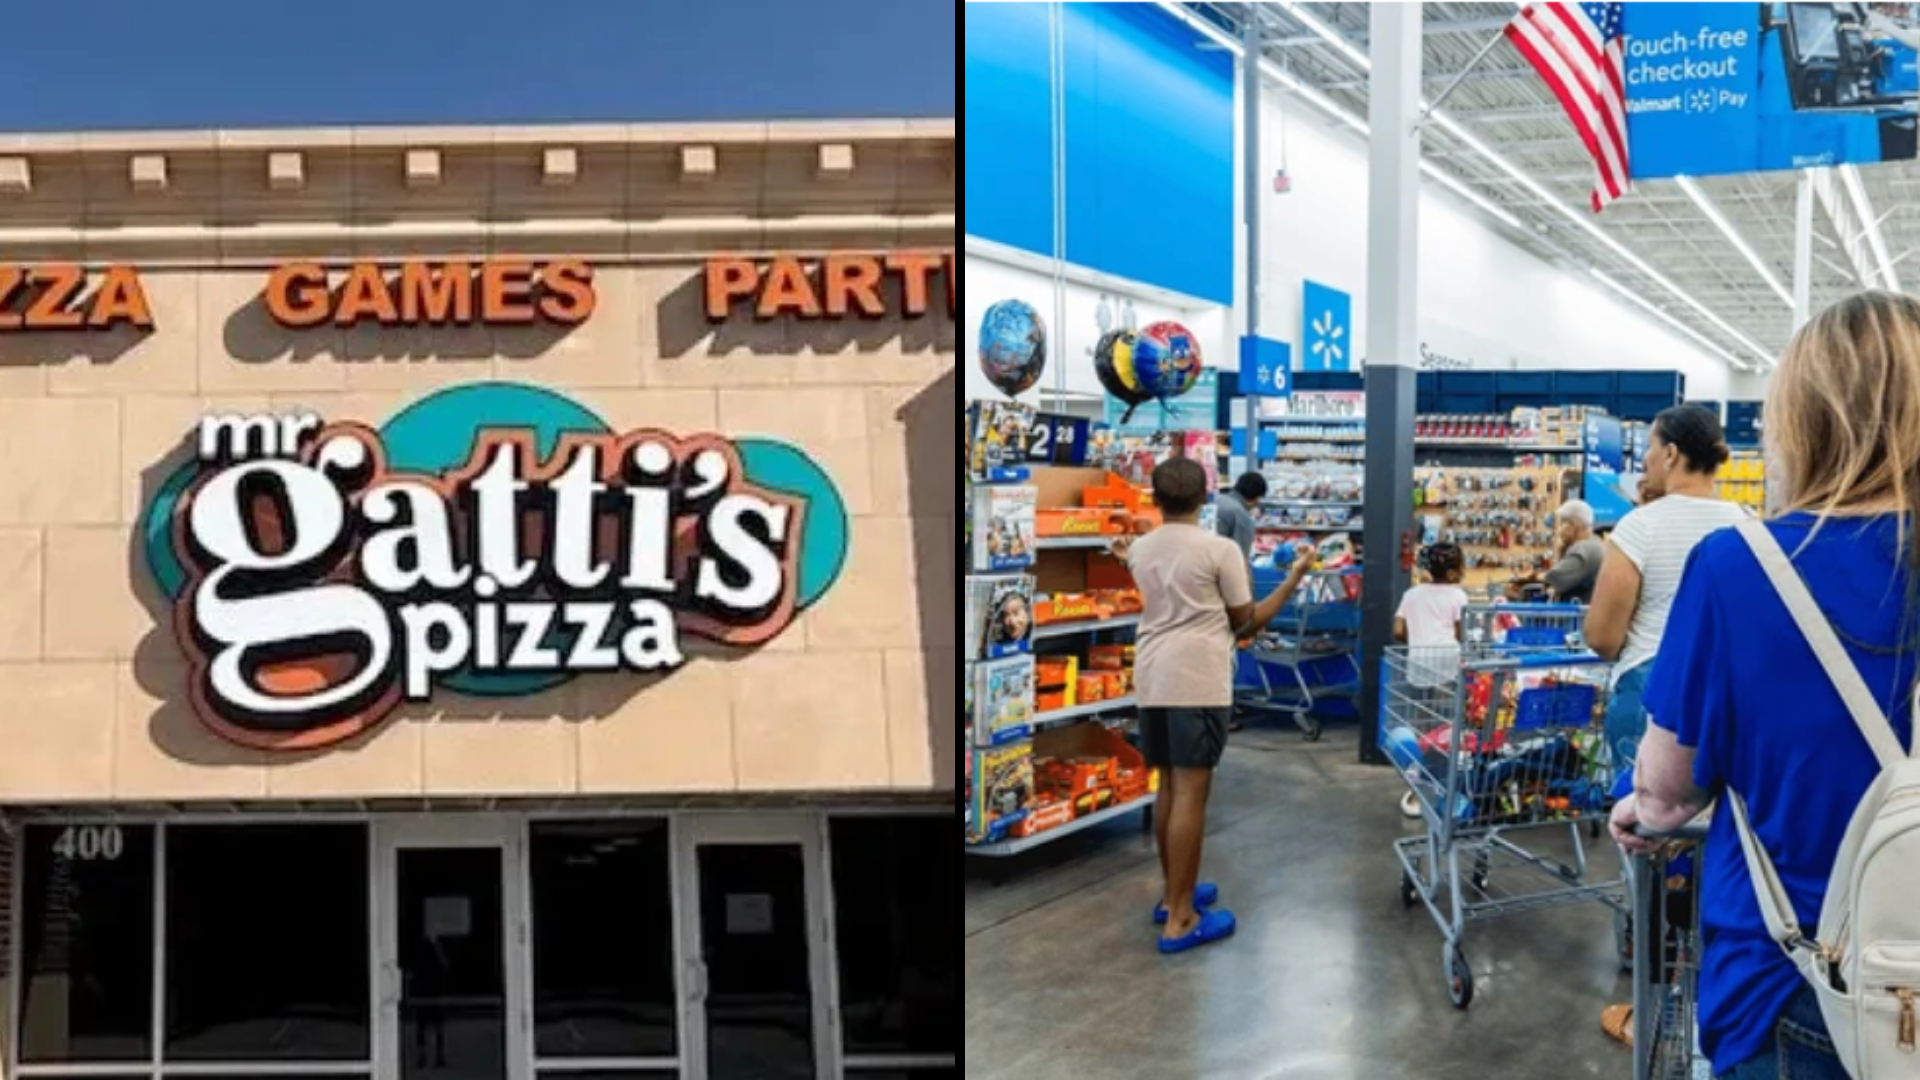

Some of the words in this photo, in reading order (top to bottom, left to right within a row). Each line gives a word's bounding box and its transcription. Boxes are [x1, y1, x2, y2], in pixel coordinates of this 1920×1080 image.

[1622, 26, 1748, 57] Touch-free
[1627, 55, 1737, 84] checkout
[1719, 89, 1748, 108] Pay
[266, 255, 596, 323] GAMES
[705, 251, 955, 318] PART
[1273, 364, 1286, 390] 6
[200, 412, 318, 457] mr
[1030, 424, 1050, 456] 2
[190, 440, 787, 714] gatti's
[399, 574, 684, 698] pizza
[52, 825, 123, 860] 400
